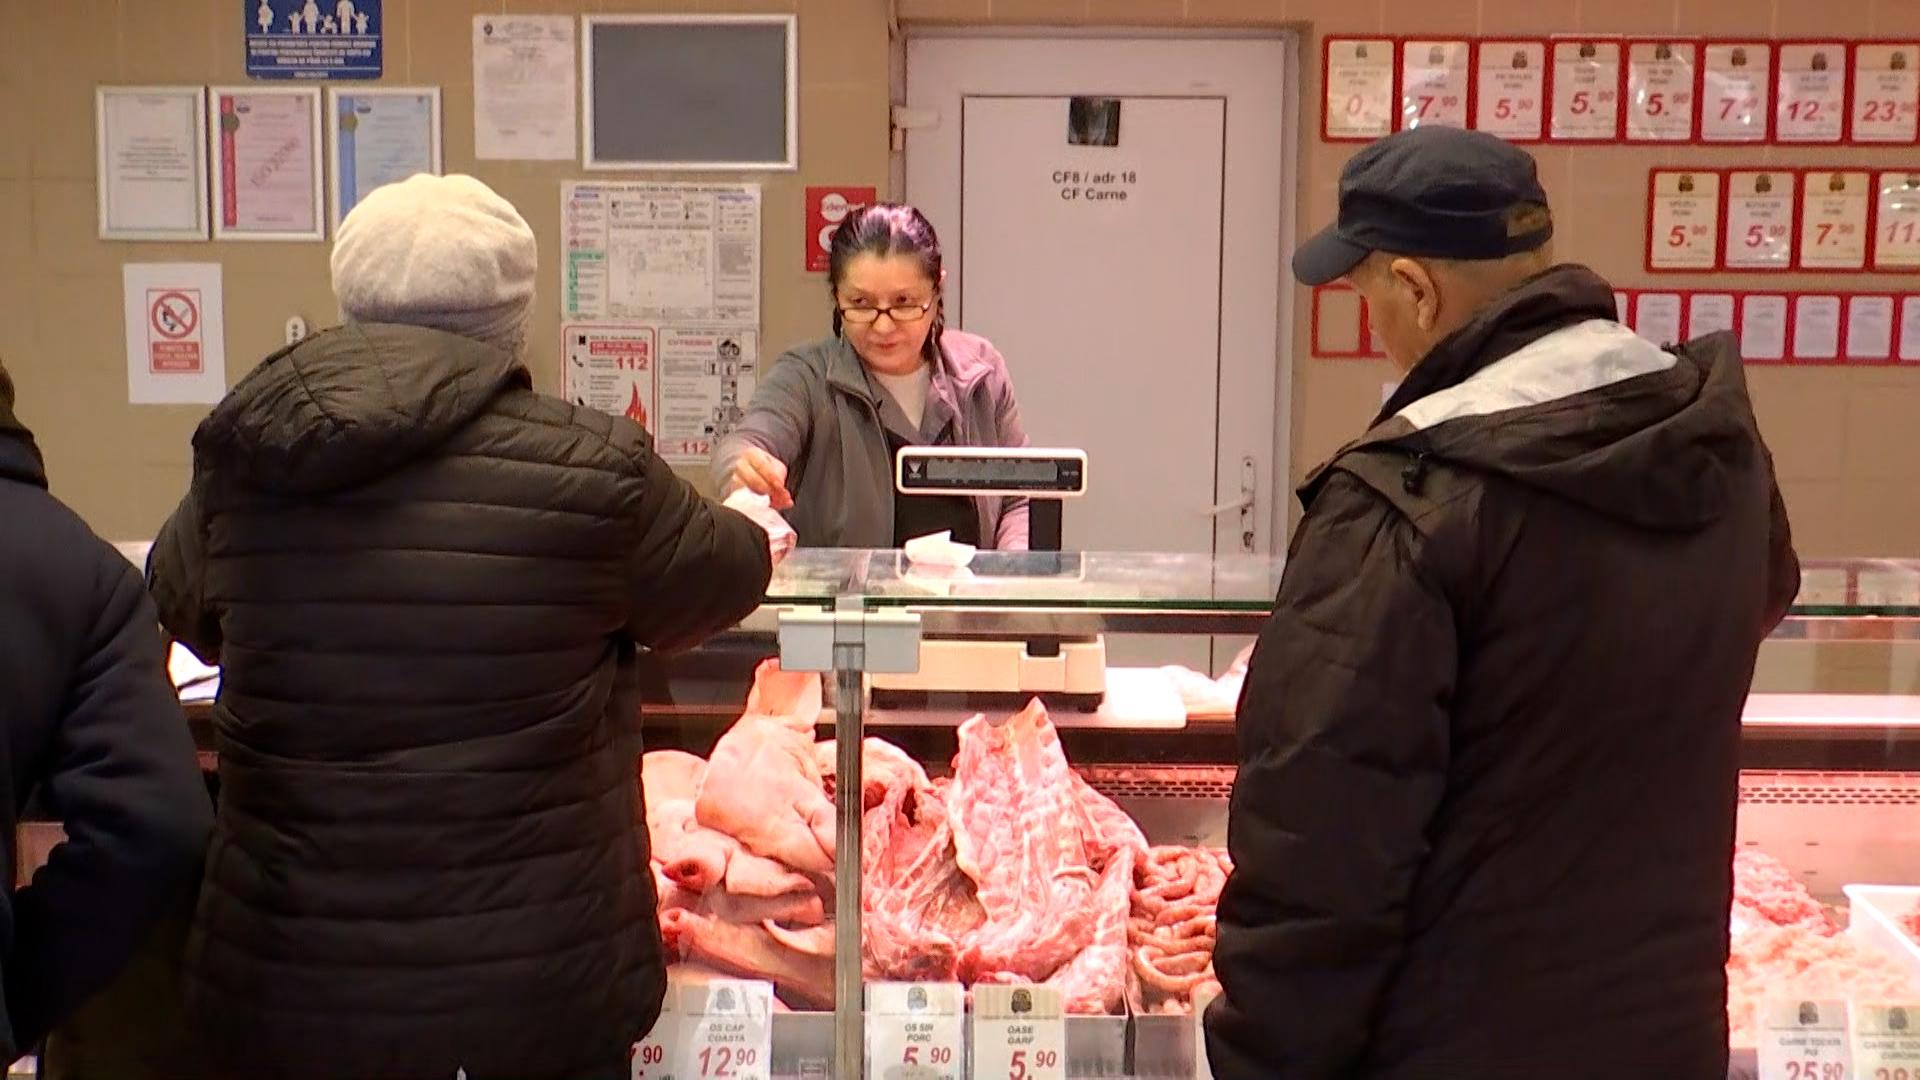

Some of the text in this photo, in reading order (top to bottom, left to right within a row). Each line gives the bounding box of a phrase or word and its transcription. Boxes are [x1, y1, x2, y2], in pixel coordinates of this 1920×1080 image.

[1052, 171, 1080, 184] CF8
[1092, 171, 1116, 184] adr
[1121, 171, 1137, 184] 18
[1060, 187, 1128, 201] CF Carne
[616, 357, 648, 370] 112
[682, 442, 709, 454] 112
[726, 1023, 745, 1032] CAP
[698, 1046, 756, 1077] 12.90
